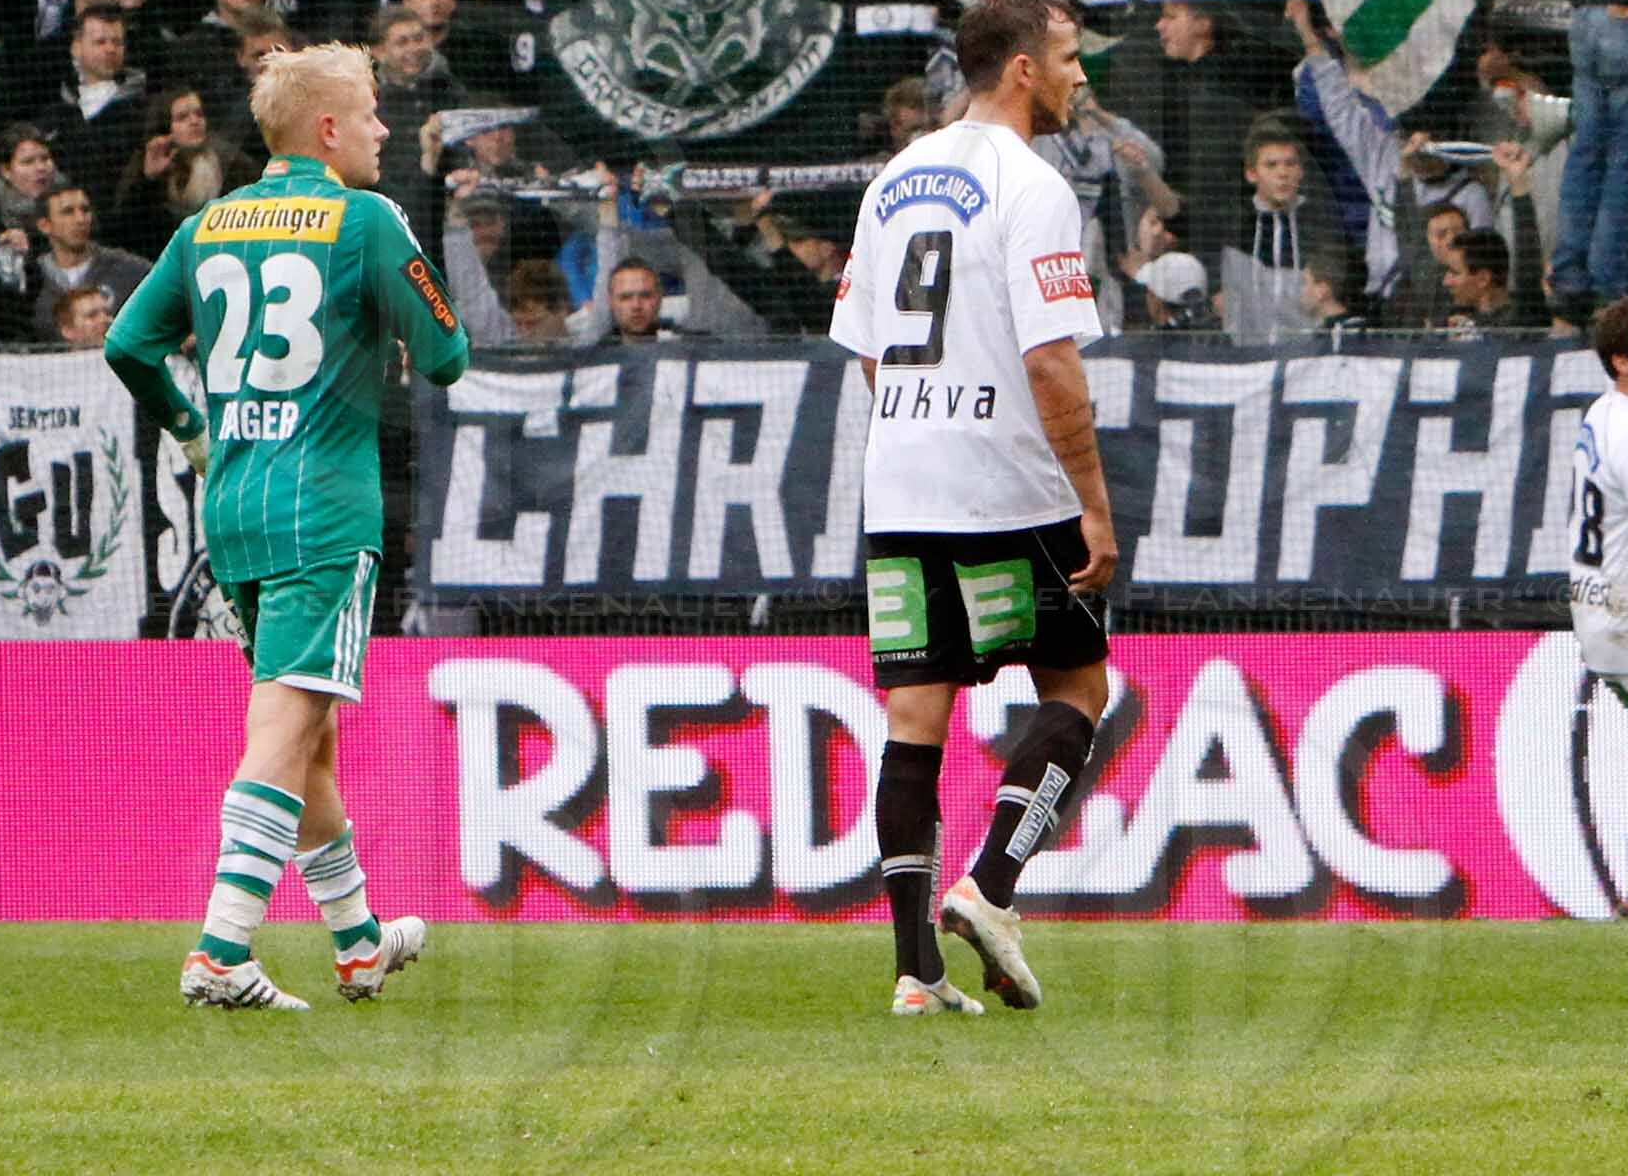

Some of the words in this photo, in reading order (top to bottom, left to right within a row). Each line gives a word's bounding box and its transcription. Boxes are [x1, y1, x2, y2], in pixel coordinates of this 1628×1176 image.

[206, 202, 330, 235] Ottakringer
[878, 173, 981, 218] PUNTIGAMER
[195, 252, 323, 394] 23
[407, 258, 457, 329] Orange
[879, 229, 954, 369] 9
[8, 405, 81, 430] SEKTION
[426, 655, 884, 896] RED
